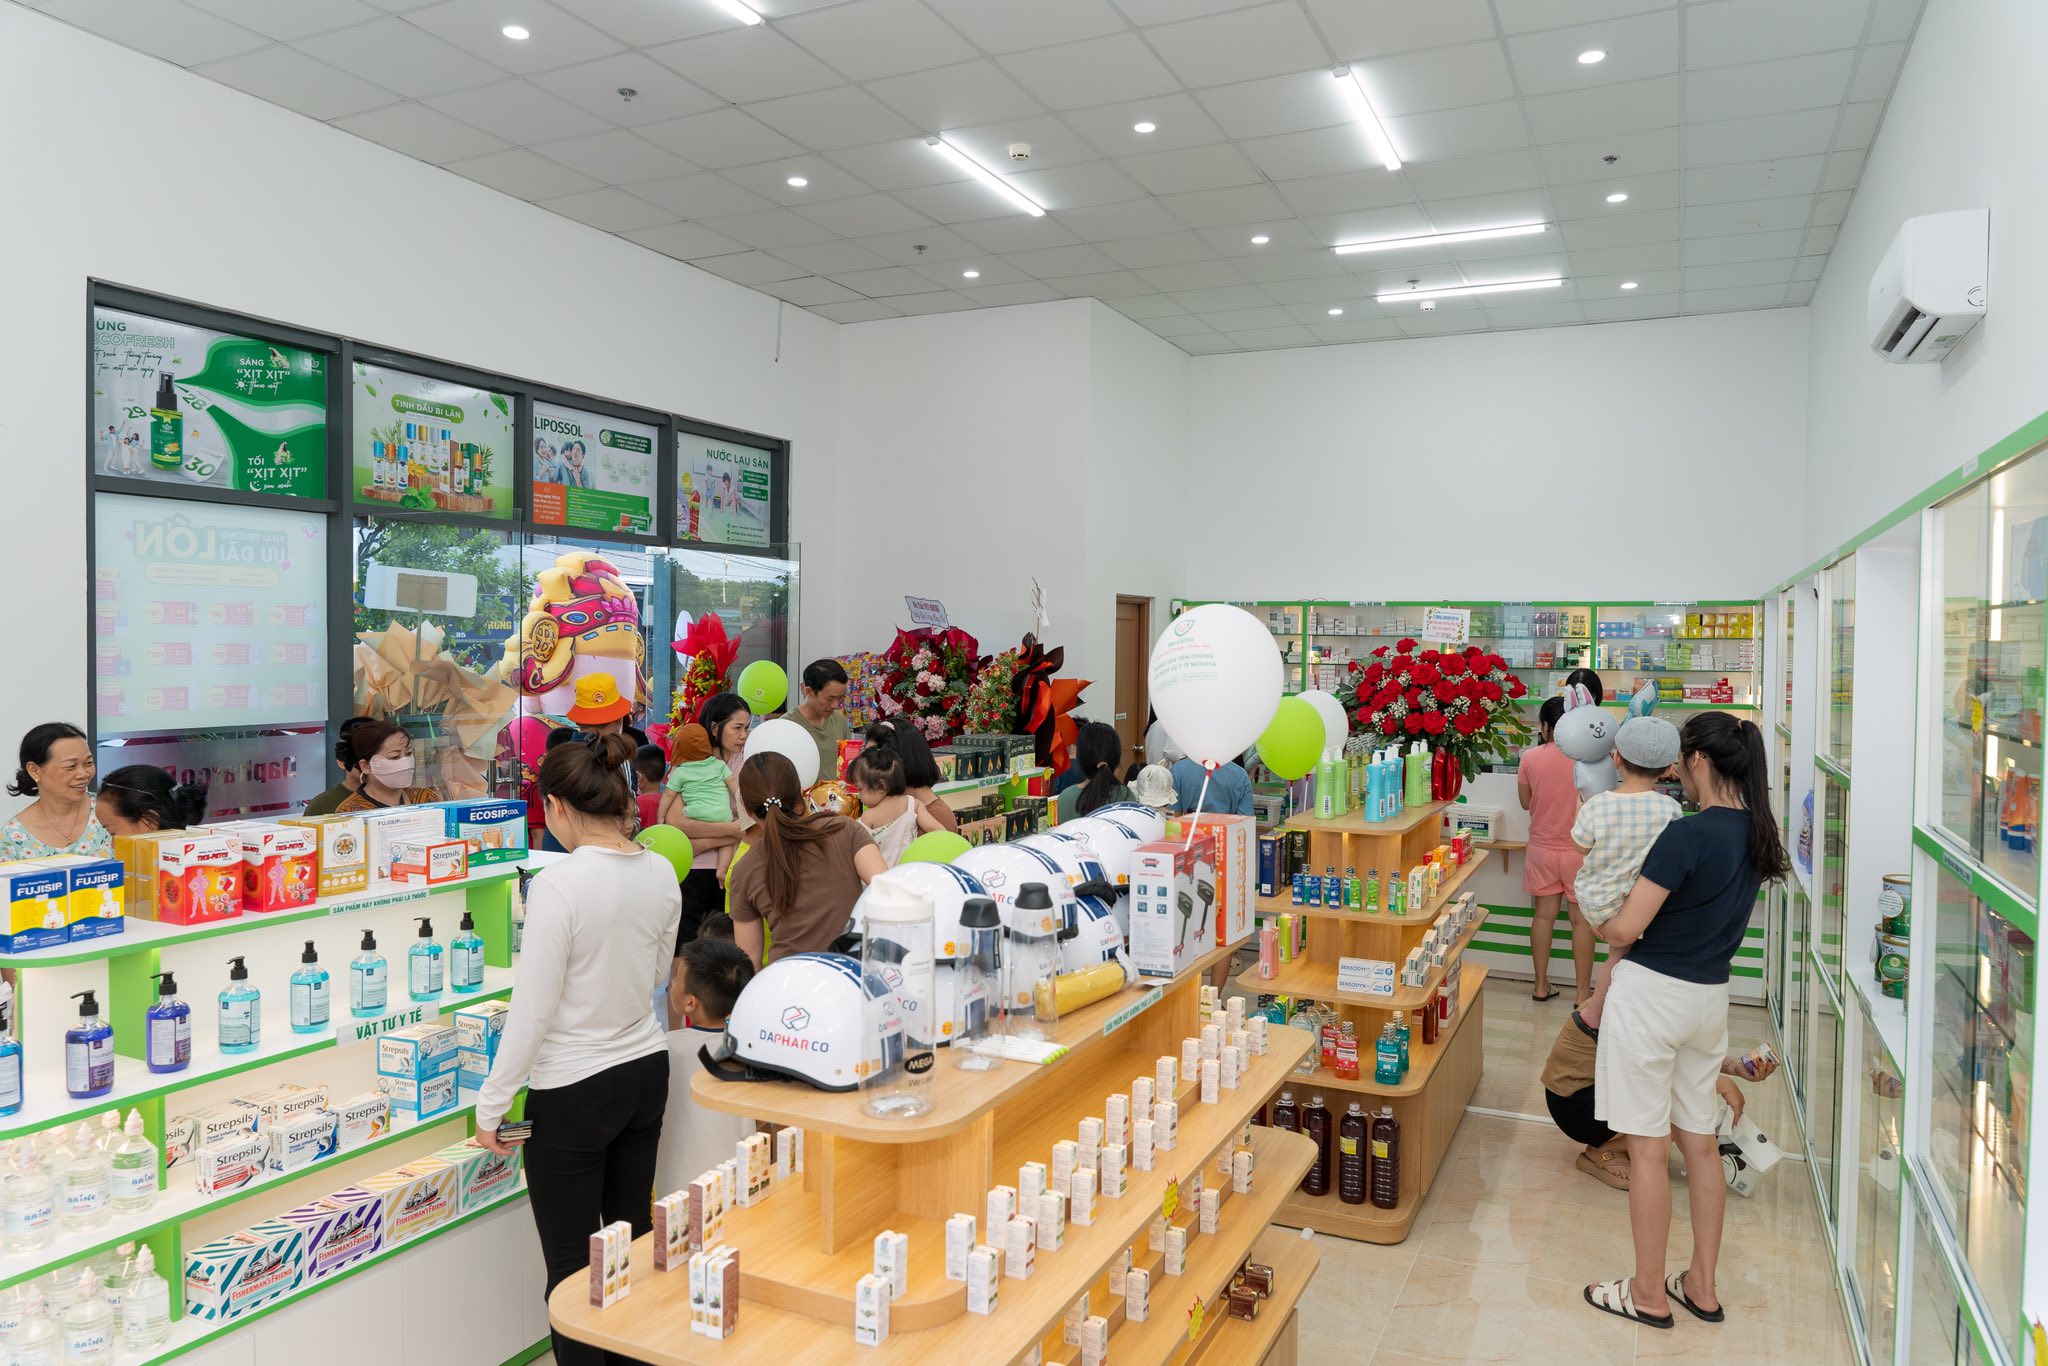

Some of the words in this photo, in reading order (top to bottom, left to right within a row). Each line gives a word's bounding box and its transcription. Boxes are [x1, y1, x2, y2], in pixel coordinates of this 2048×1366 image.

[240, 357, 264, 367] SÁNG
[182, 394, 207, 411] 28
[395, 400, 415, 410] TINH
[435, 407, 443, 415] BI
[123, 406, 147, 419] 29
[534, 416, 583, 438] LIPOSSOL
[247, 455, 265, 466] TỐI
[706, 448, 732, 462] NƯỚC
[734, 456, 750, 466] LAU
[752, 457, 769, 470] SÀN
[184, 456, 216, 477] 30
[487, 620, 512, 630] RUNG
[470, 809, 508, 821] ECOSIP
[432, 849, 460, 860] Strepsils
[75, 873, 119, 887] FUJISIP
[17, 882, 63, 897] FUJISIP
[72, 924, 85, 932] 200
[13, 935, 28, 943] 200
[356, 1022, 378, 1040] VẬT
[382, 1015, 397, 1030] TƯ
[399, 1014, 406, 1027] Y
[409, 1005, 423, 1022] TẾ
[458, 1020, 482, 1031] Strepsils
[759, 1029, 829, 1053] DAPHARCO
[382, 1044, 409, 1055] Strepsils
[908, 1057, 933, 1070] MEGA
[423, 1079, 451, 1094] Strepsils
[284, 1094, 325, 1113] Strepsils
[345, 1101, 387, 1122] Strepsils
[206, 1113, 253, 1134] Strepsils
[288, 1122, 333, 1143] Strepsils
[216, 1144, 262, 1167] Strepsils
[497, 1170, 512, 1182] FRIEND
[429, 1200, 447, 1213] FRIEND
[354, 1232, 372, 1246] FRIEND
[271, 1267, 292, 1282] FRIEND
